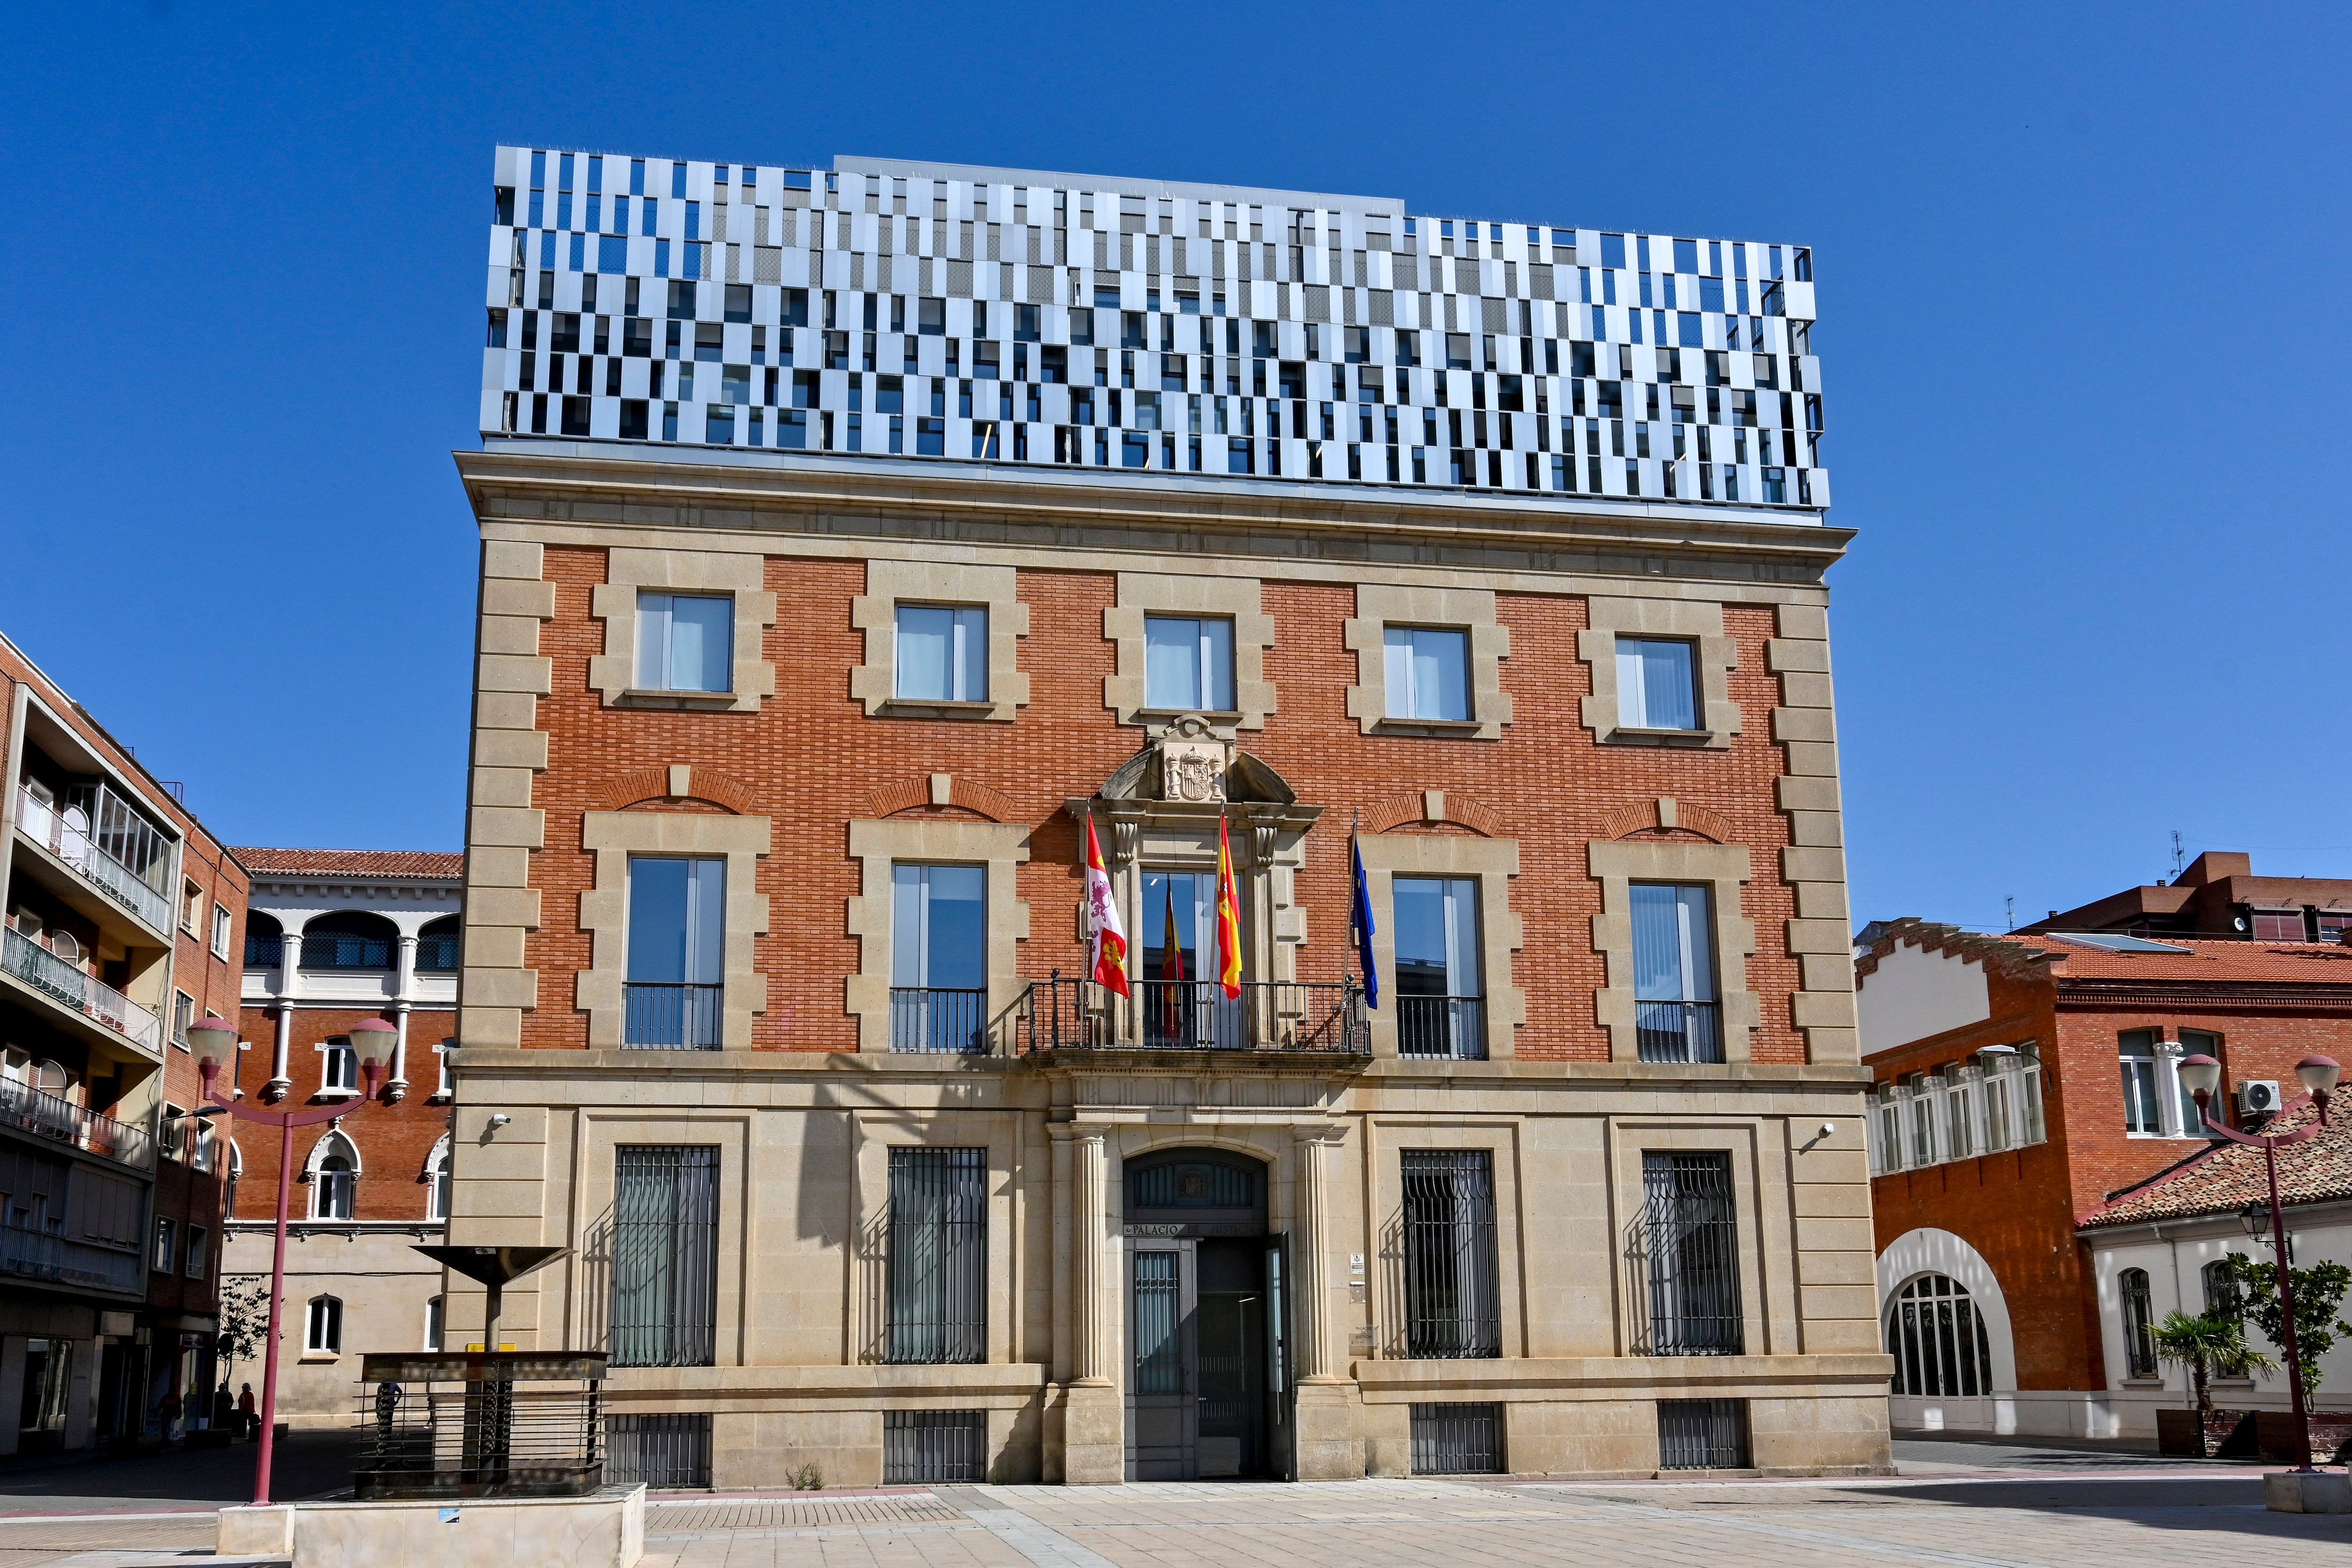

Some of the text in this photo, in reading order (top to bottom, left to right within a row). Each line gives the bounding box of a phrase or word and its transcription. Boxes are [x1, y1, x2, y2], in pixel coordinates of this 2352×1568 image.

[1133, 1225, 1258, 1234] PALACIO DE JUSTICIA
